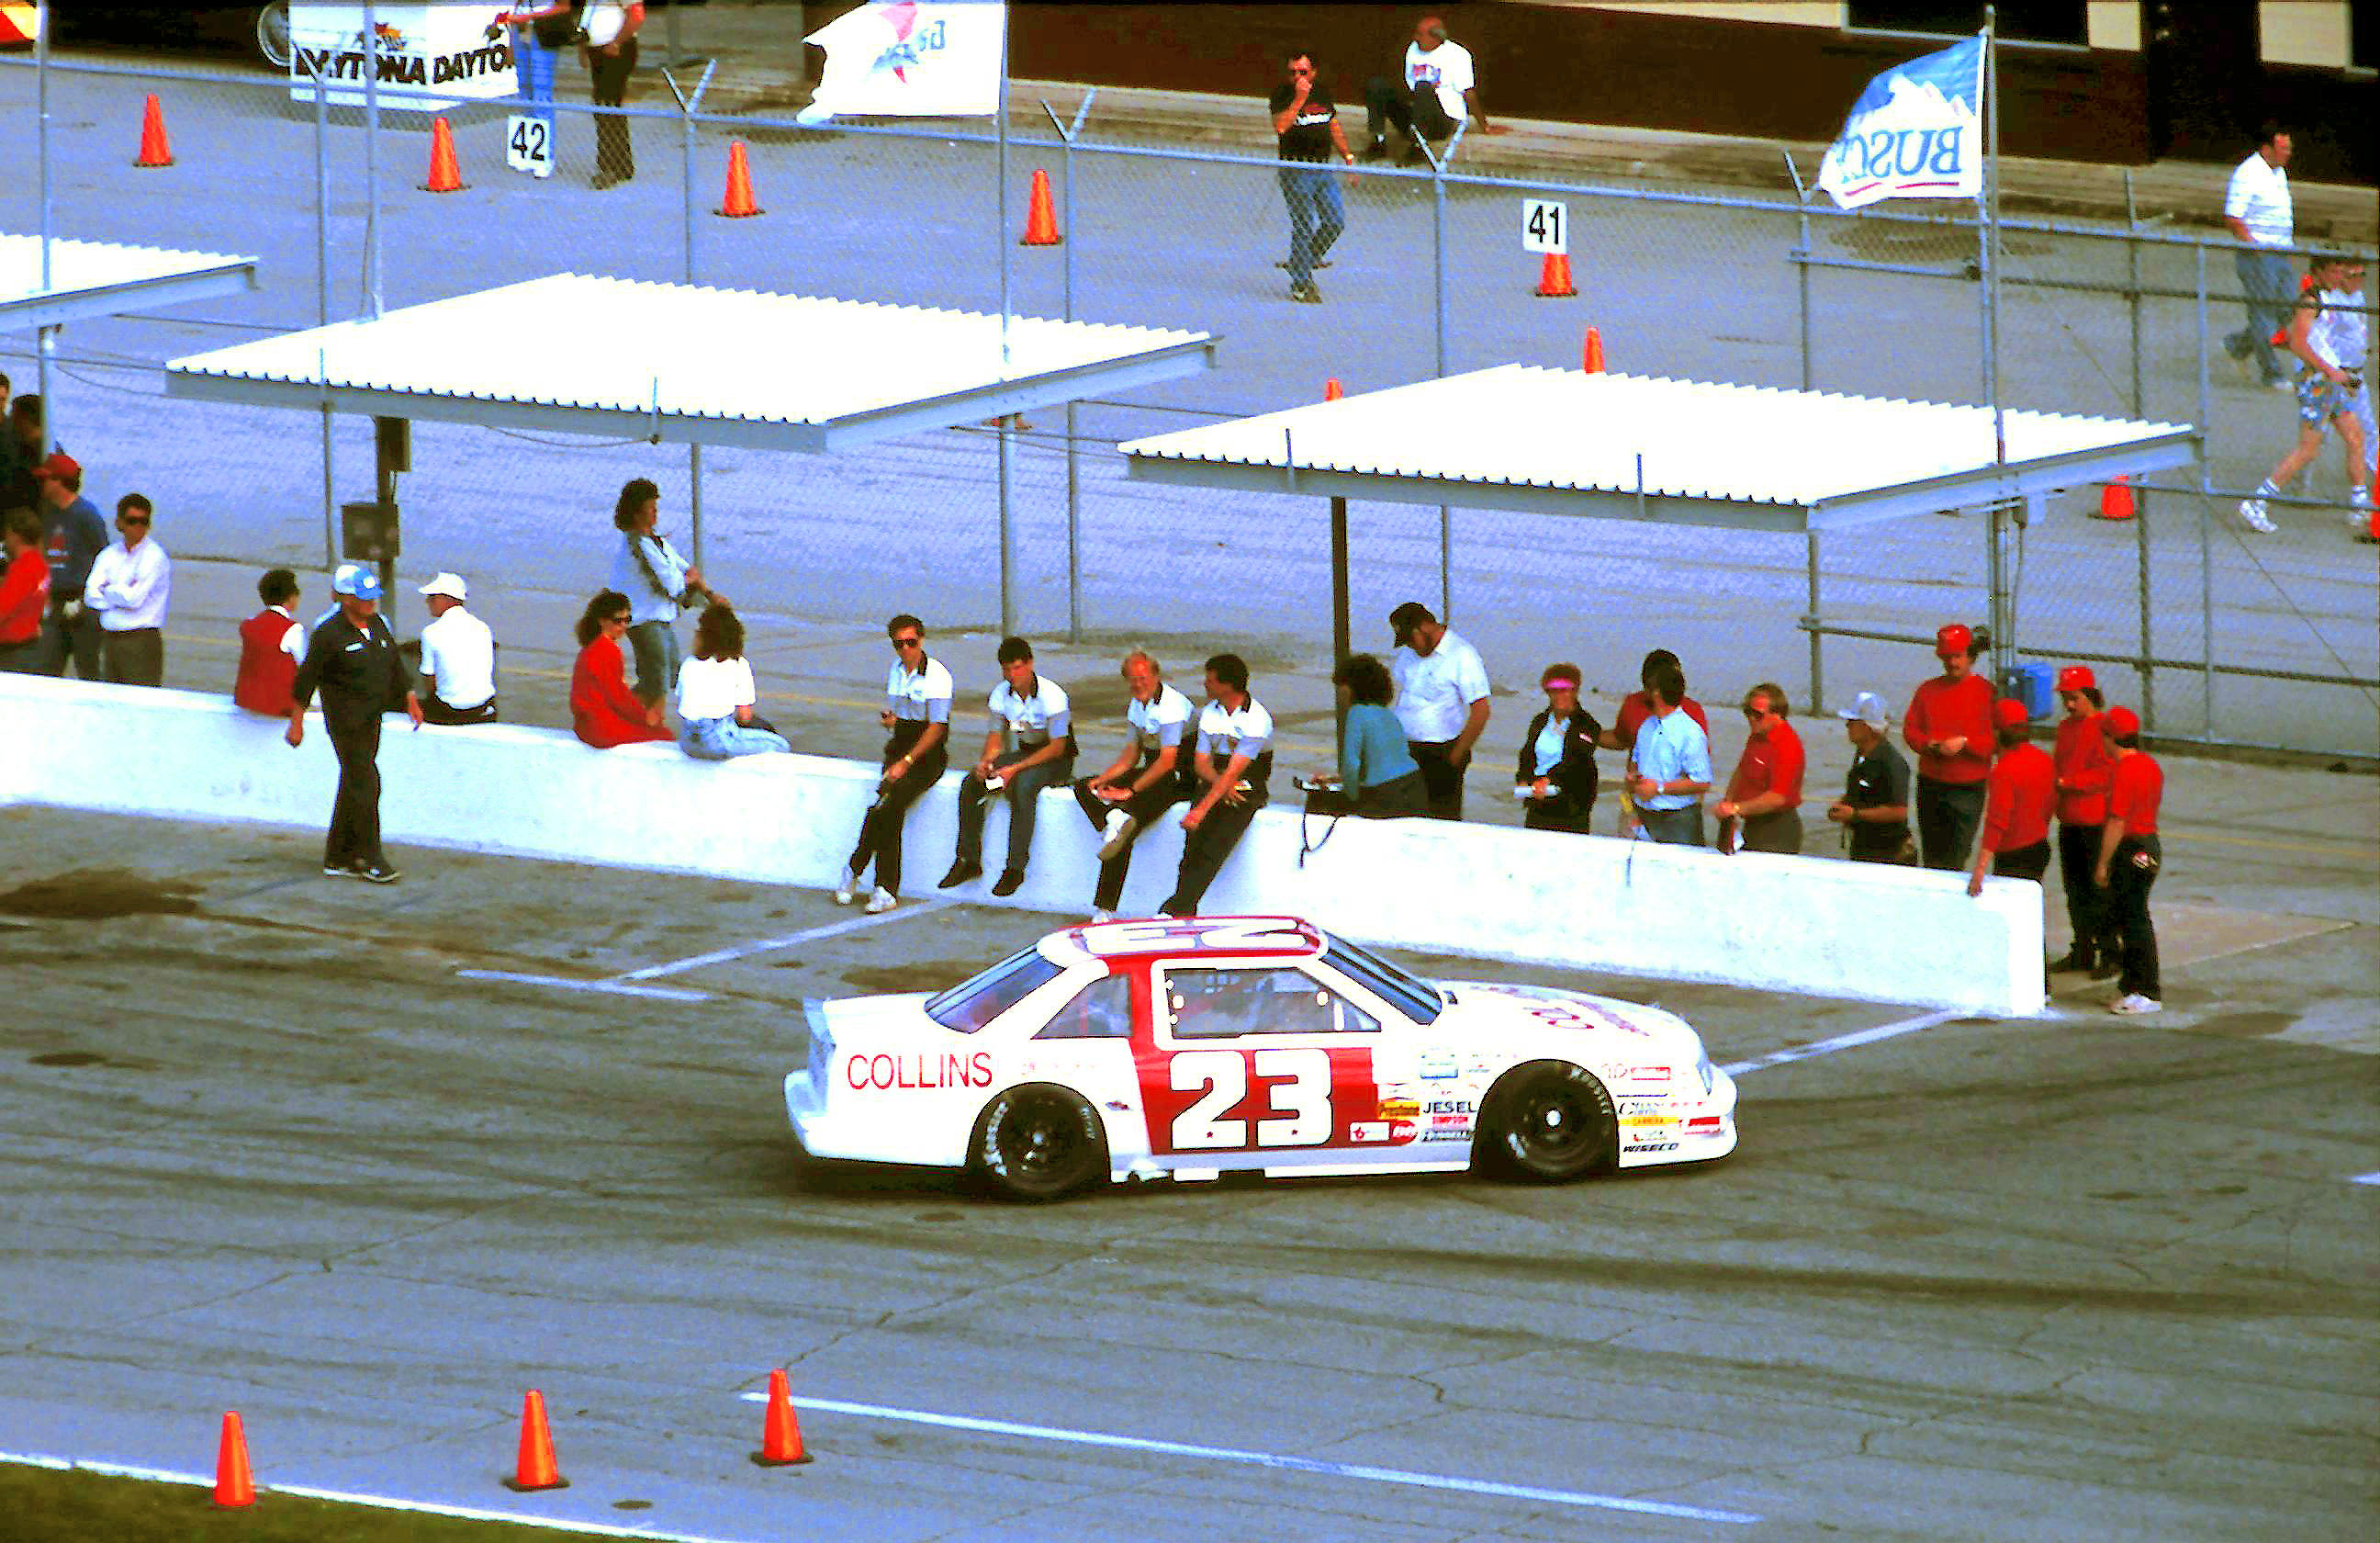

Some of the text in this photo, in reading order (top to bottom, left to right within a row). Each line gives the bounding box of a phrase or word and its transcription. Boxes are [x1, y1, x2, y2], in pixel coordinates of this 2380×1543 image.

[511, 120, 545, 162] 42
[1529, 204, 1559, 245] 41
[848, 1052, 993, 1090] COLLINS
[1169, 1048, 1333, 1150] 23
[1423, 1101, 1477, 1114] JESEL
[1622, 1142, 1680, 1154] WISECO
